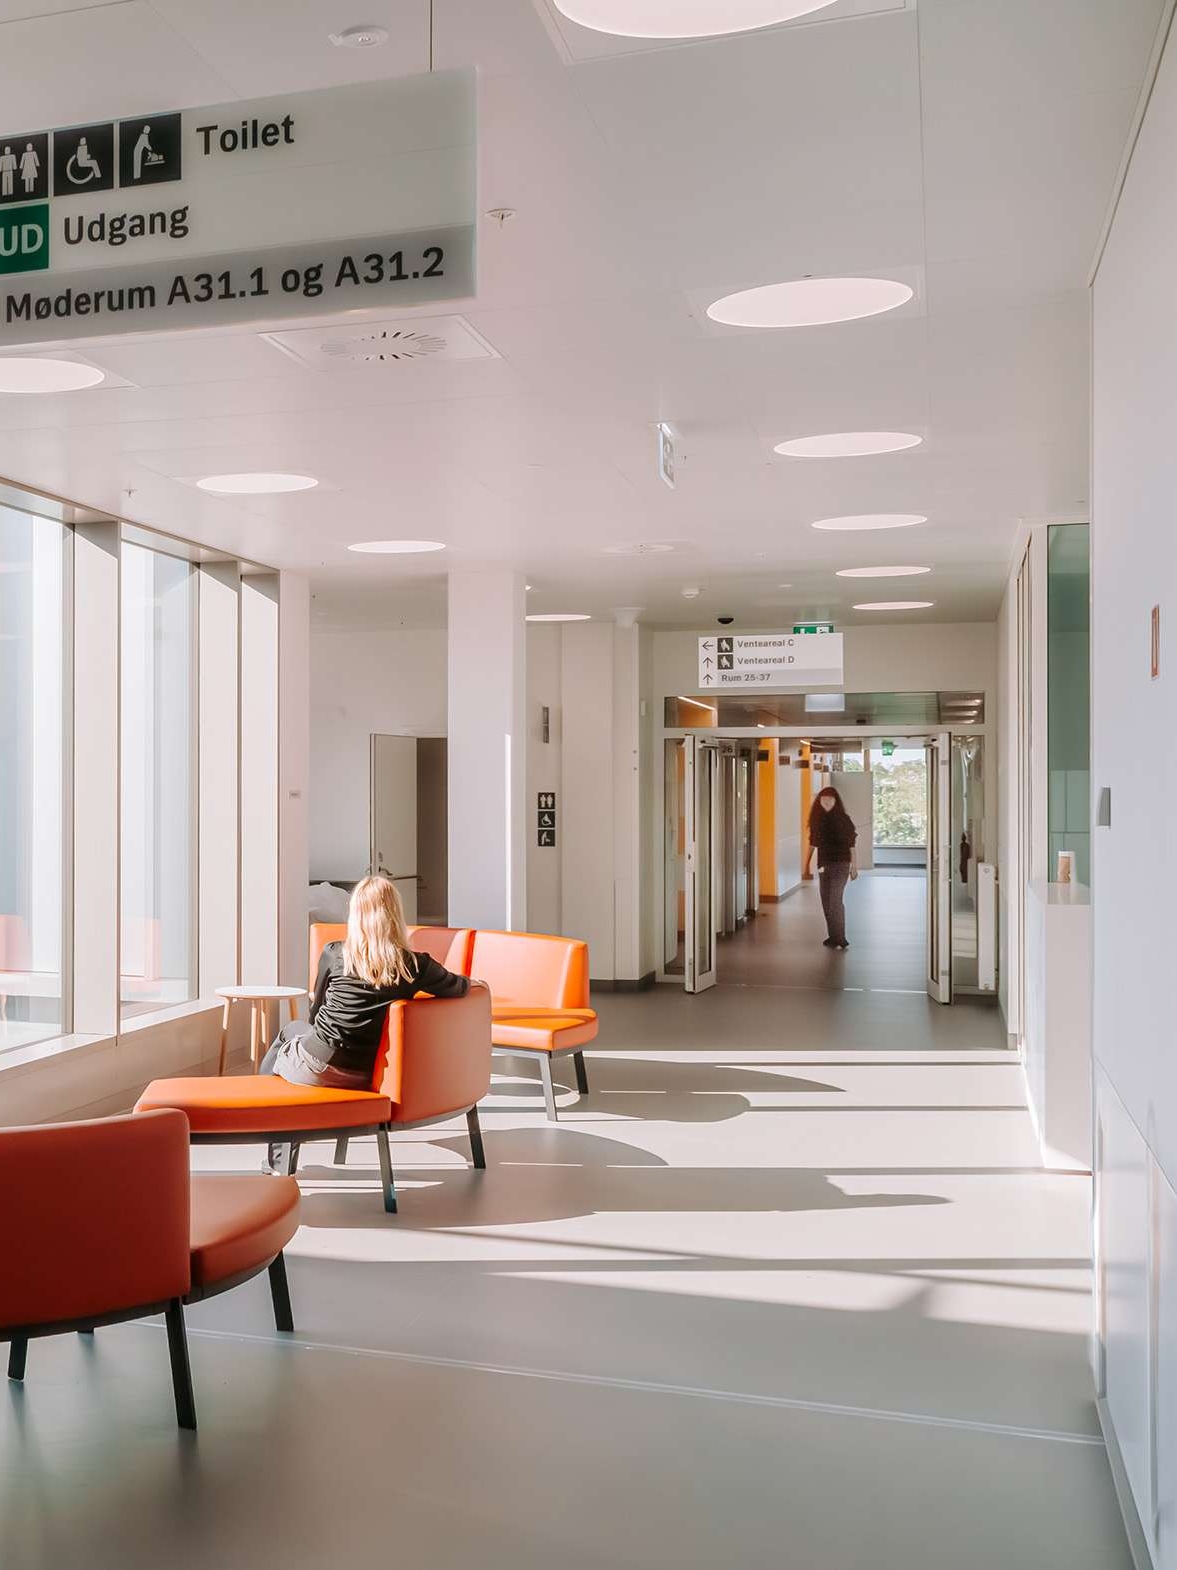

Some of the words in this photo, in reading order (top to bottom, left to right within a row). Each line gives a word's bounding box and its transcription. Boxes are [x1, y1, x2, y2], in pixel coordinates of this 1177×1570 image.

[196, 114, 295, 155] Toilet
[64, 201, 189, 246] Udgang
[6, 289, 155, 323] Møderum
[167, 266, 269, 305] A31.1
[281, 263, 324, 297] og
[334, 247, 444, 287] A31.2
[737, 640, 785, 648] Venteareal
[737, 657, 785, 665] Venteareal
[788, 656, 795, 664] D
[745, 673, 771, 681] 25-37
